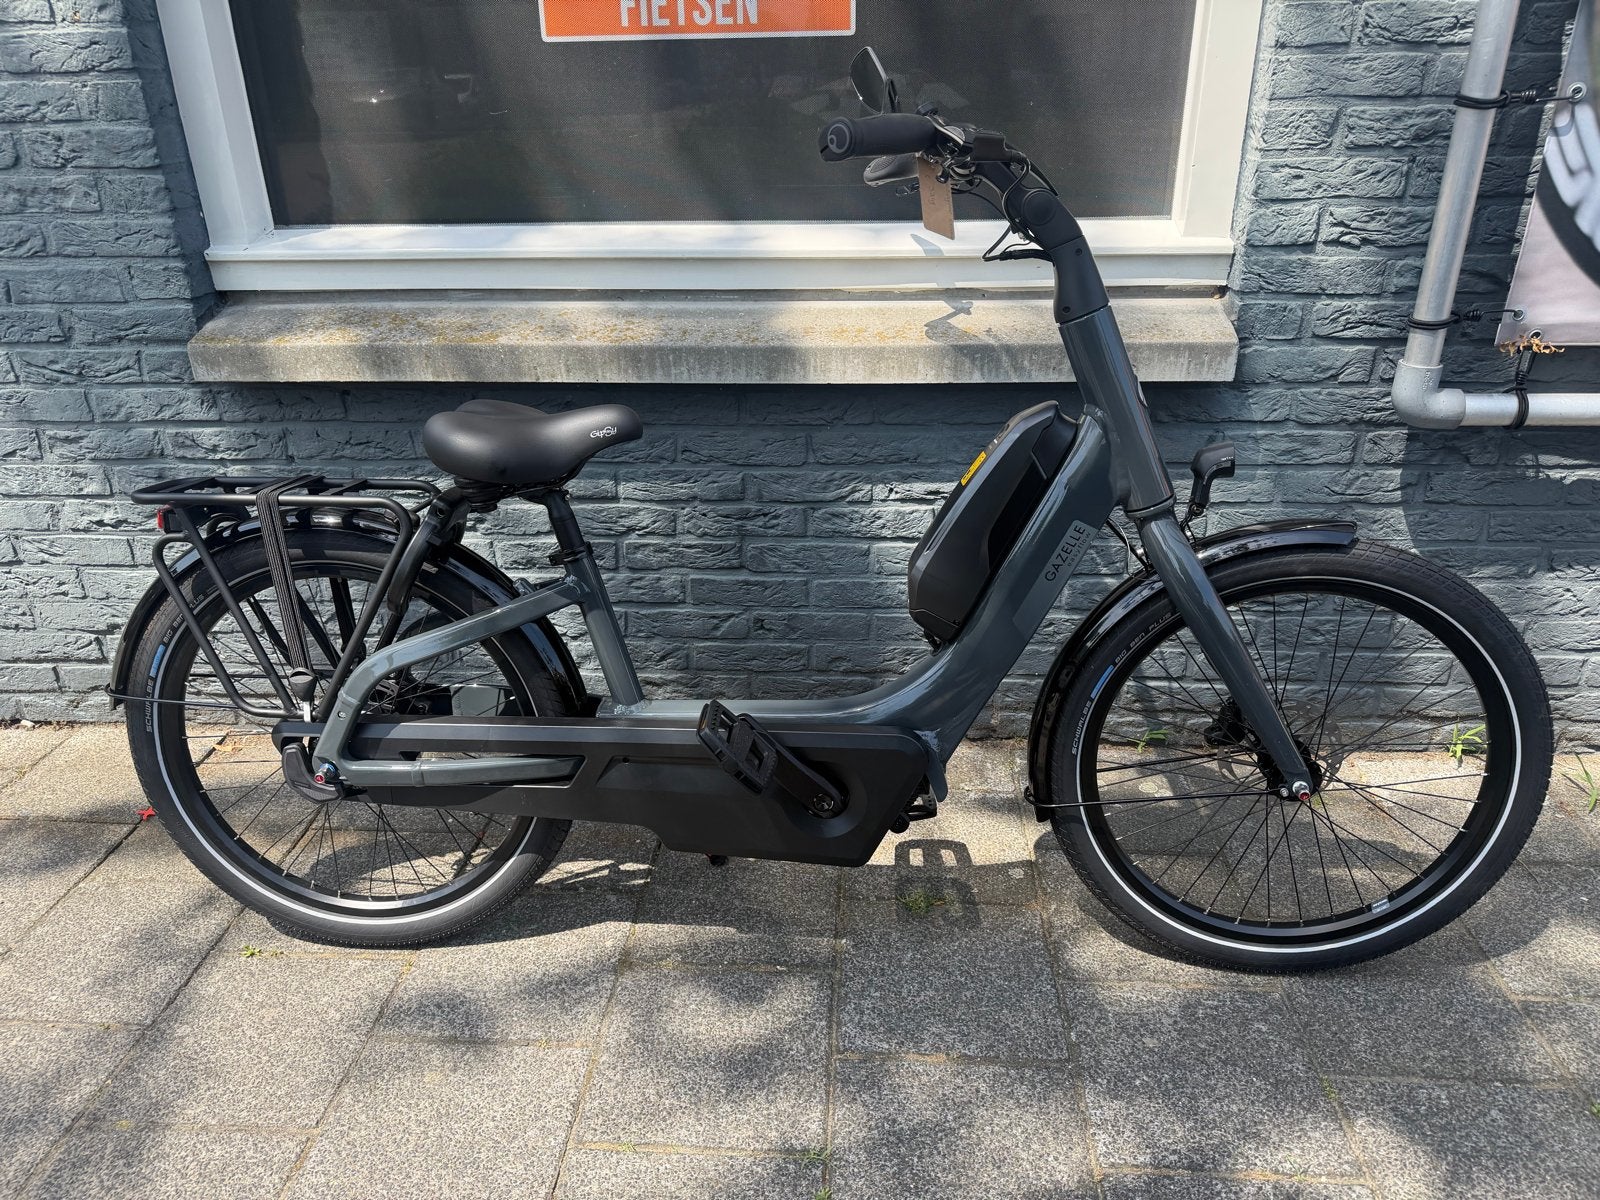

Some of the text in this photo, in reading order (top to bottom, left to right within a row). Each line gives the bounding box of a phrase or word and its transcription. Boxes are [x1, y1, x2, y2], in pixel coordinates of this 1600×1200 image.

[620, 0, 758, 27] FIETSEN
[1044, 525, 1086, 582] GAZELLE
[1071, 701, 1092, 755] SCHWALBE
